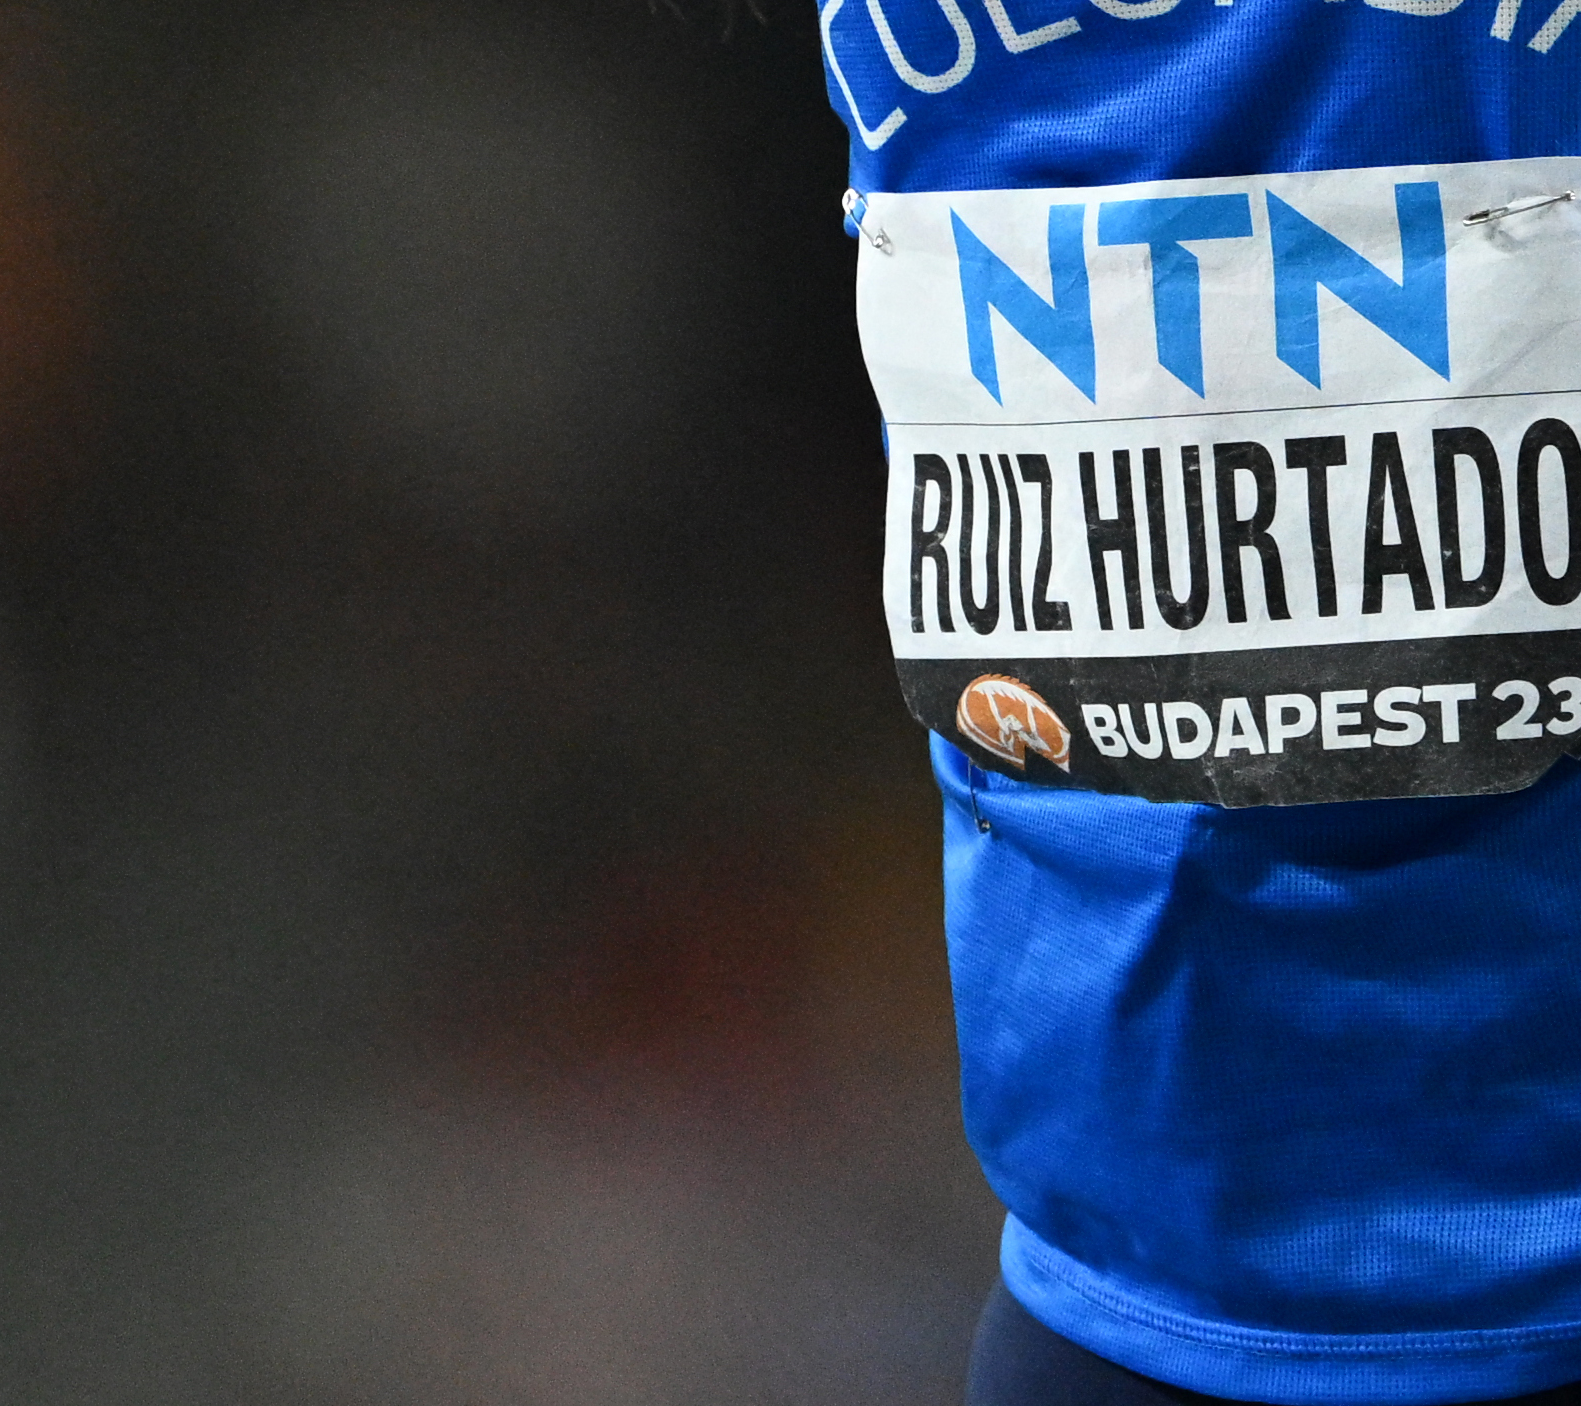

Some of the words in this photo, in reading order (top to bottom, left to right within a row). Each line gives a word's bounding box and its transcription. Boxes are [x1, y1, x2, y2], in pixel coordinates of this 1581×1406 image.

[950, 181, 1450, 408] NTN
[910, 452, 1073, 636] RUIZ
[1081, 683, 1478, 759] BUDAPEST
